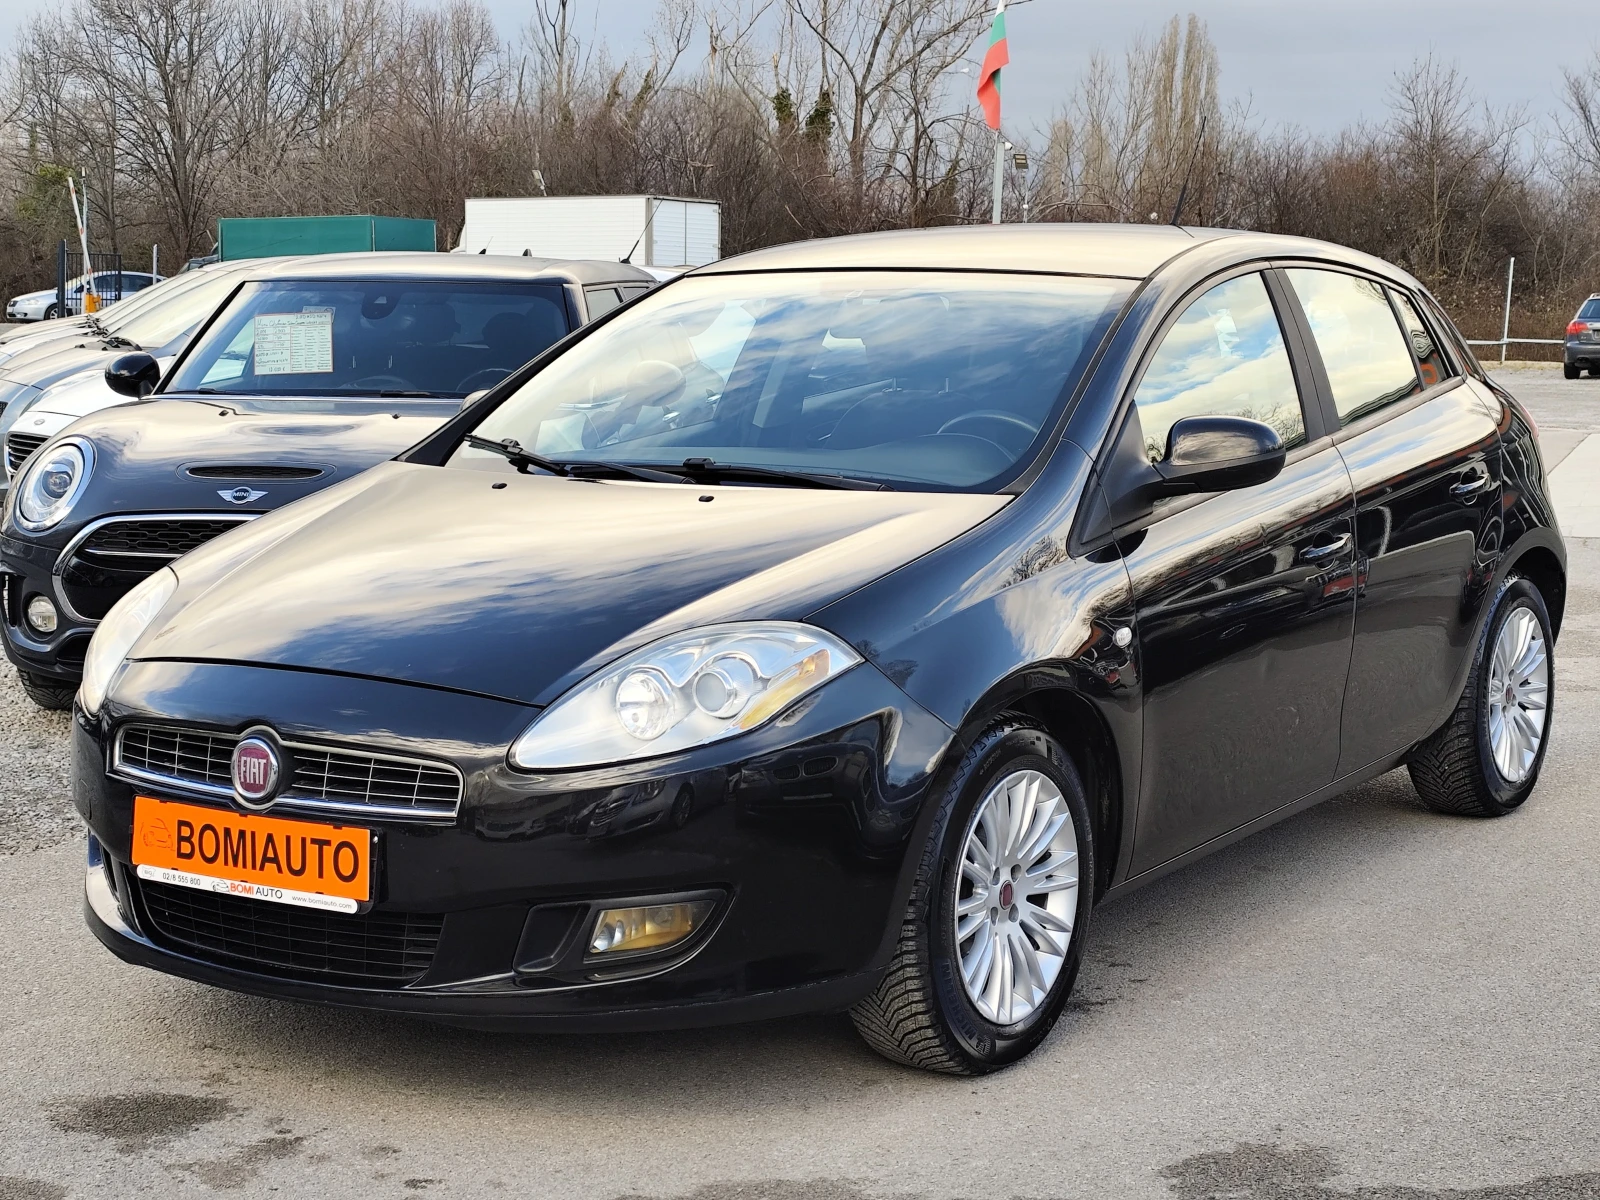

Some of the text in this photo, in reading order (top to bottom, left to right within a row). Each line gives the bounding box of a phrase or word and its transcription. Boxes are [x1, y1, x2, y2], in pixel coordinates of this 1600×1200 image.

[240, 756, 267, 785] FIAT
[176, 819, 359, 883] BOMIAUTO
[177, 875, 189, 884] 555
[189, 878, 201, 886] 800
[229, 882, 283, 899] BOMI AUTO
[291, 894, 352, 909] www.bomiauto.com
